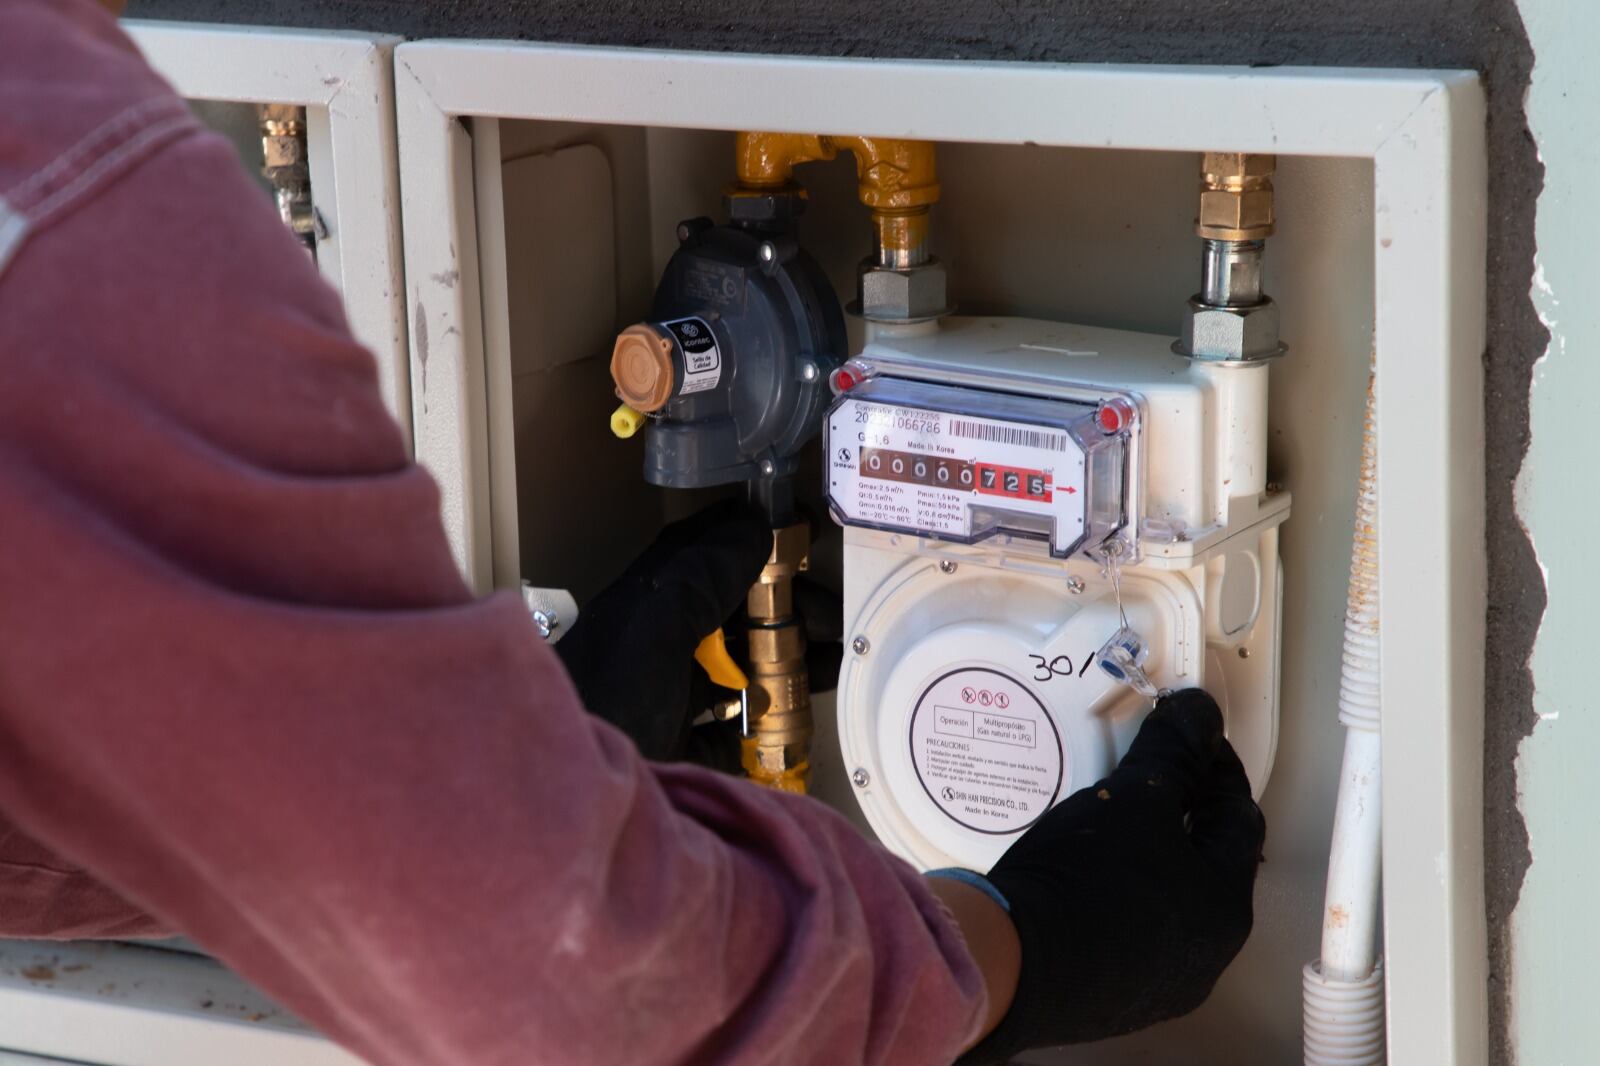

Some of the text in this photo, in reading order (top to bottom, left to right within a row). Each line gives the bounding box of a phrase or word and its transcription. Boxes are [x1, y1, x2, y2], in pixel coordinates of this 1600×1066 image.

[855, 411, 941, 434] 201066786
[907, 440, 925, 450] Made
[936, 444, 955, 454] Korea
[939, 715, 969, 727] Operación
[983, 717, 1026, 731] Multipropósito
[977, 727, 990, 736] (Gas
[991, 730, 1011, 739] natural
[1018, 734, 1032, 743] LPG)
[926, 737, 970, 751] PRECAUCIONES
[955, 791, 967, 801] SHIN
[967, 793, 979, 804] HAN
[979, 794, 1006, 807] PRECISION
[964, 805, 981, 815] Made
[990, 810, 1009, 819] Korea
